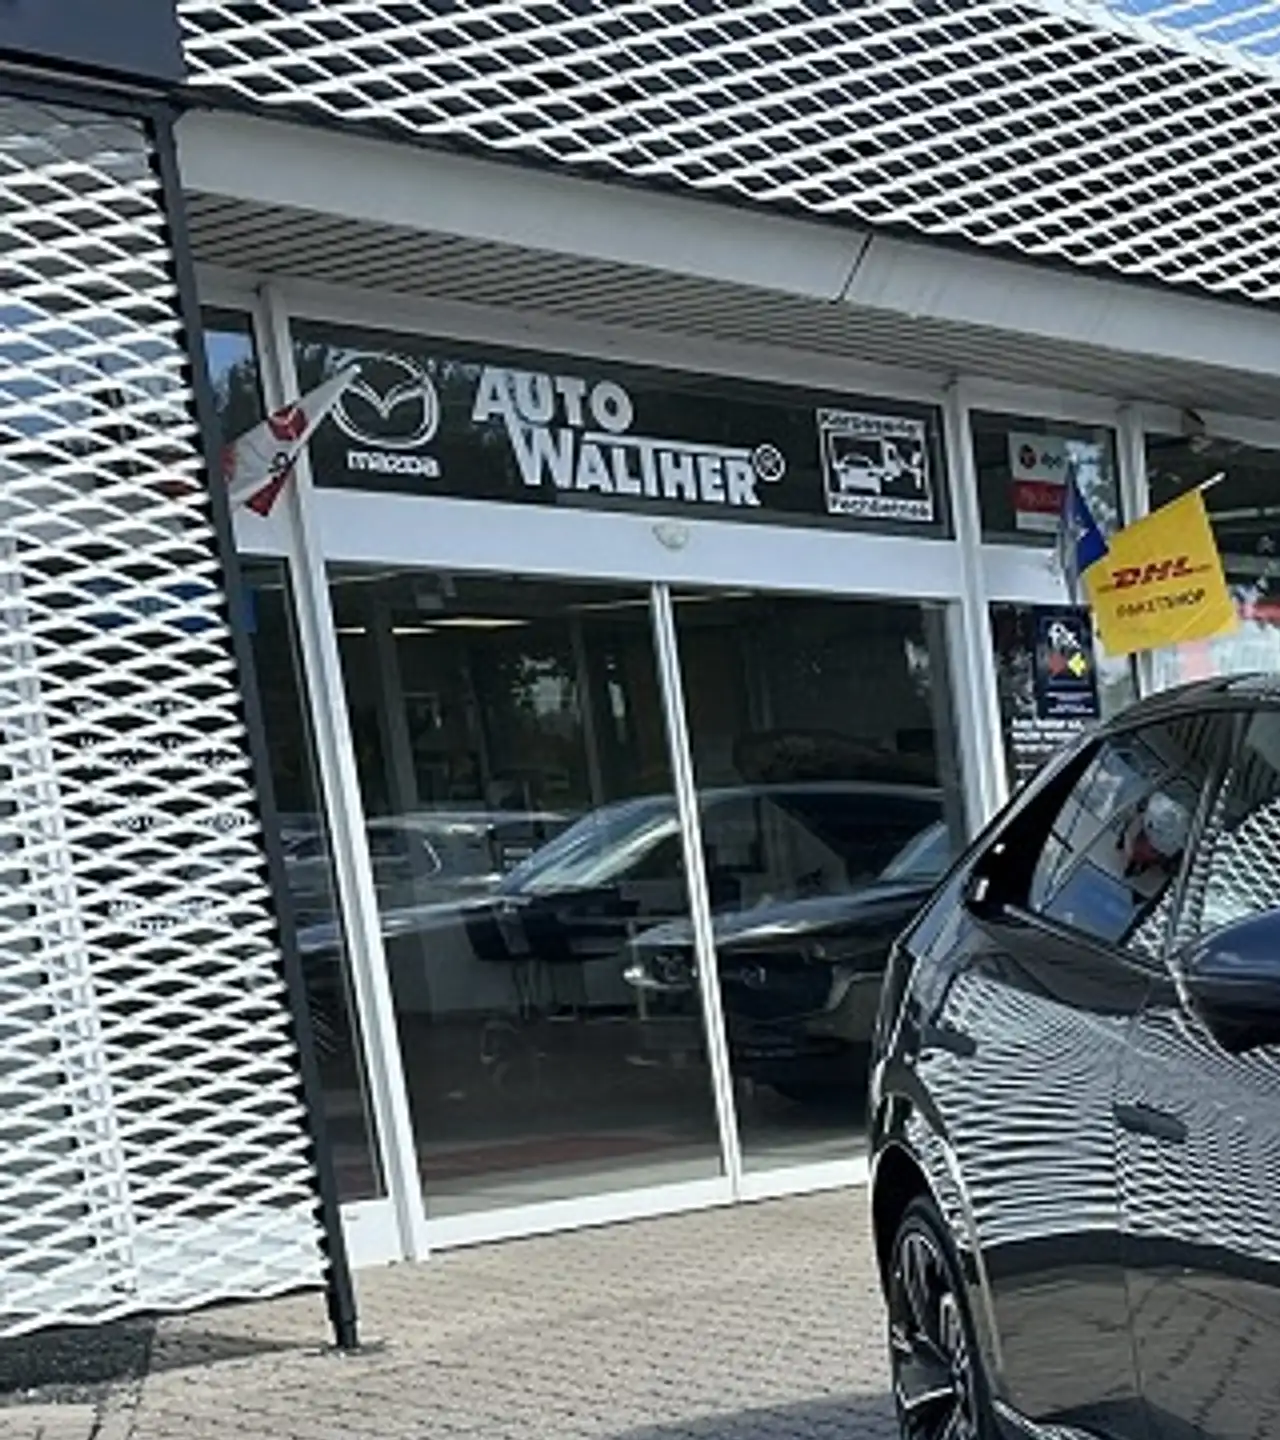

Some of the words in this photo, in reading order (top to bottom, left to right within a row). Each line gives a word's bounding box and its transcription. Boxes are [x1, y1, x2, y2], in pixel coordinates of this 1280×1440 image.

[472, 366, 633, 433] AUTO
[347, 450, 441, 478] mazda
[1112, 556, 1193, 589] DHL
